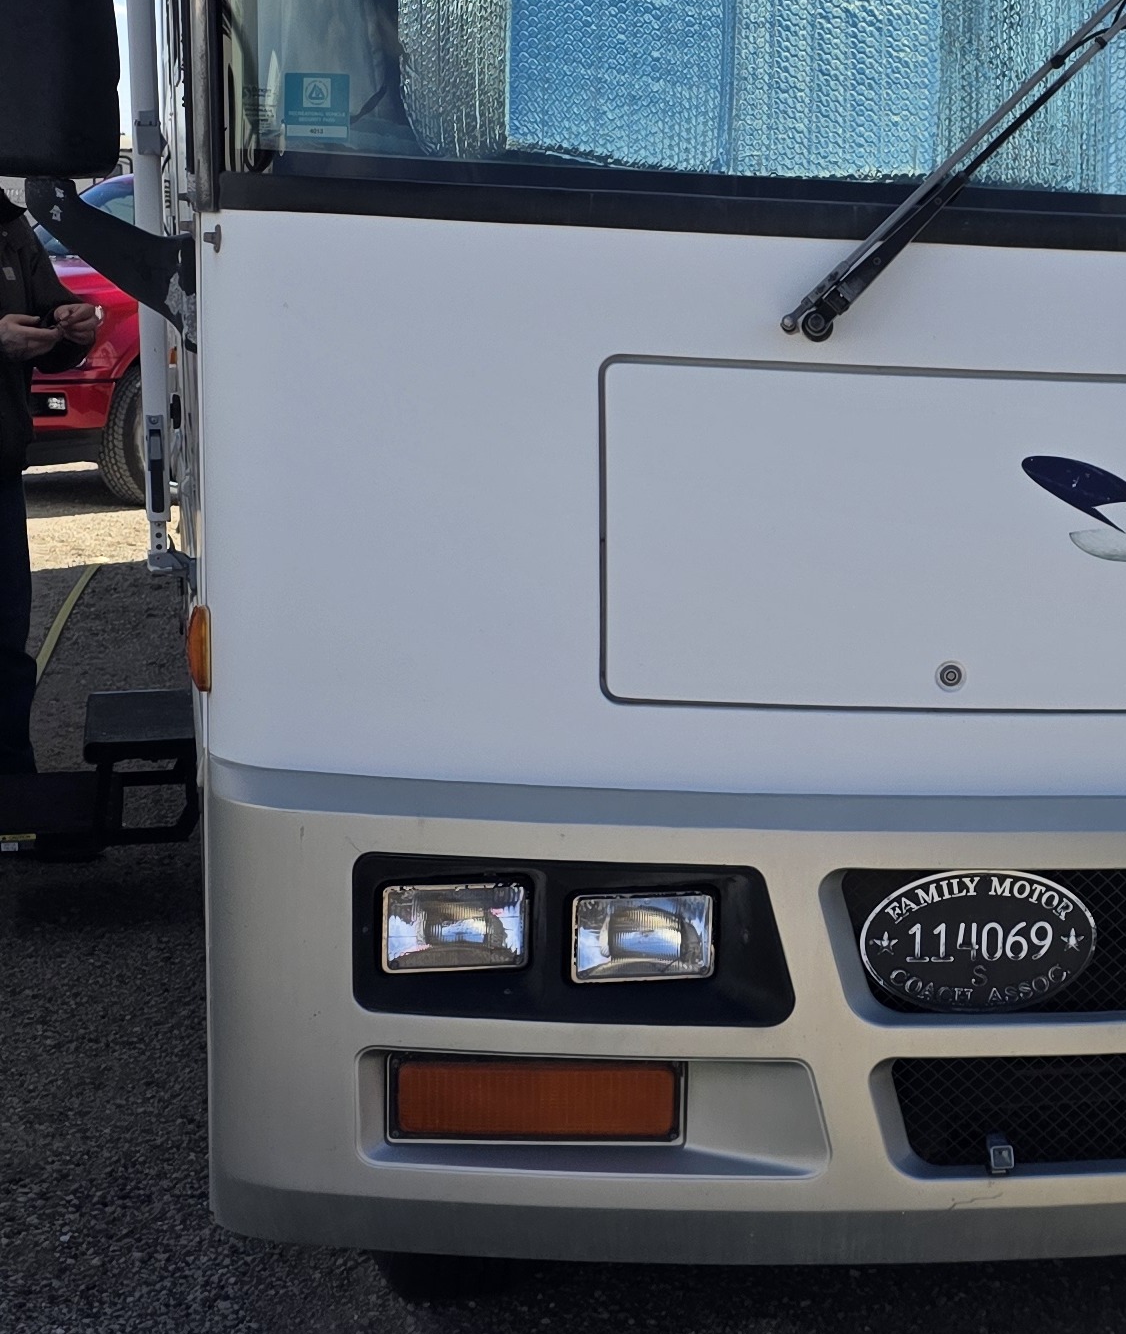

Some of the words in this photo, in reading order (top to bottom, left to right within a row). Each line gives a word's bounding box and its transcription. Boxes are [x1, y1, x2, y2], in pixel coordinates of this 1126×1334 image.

[885, 876, 981, 925] FAMILY
[989, 876, 1074, 921] MOTOR
[906, 920, 1054, 963] 114069
[889, 969, 974, 1004] COACH
[971, 965, 988, 987] S
